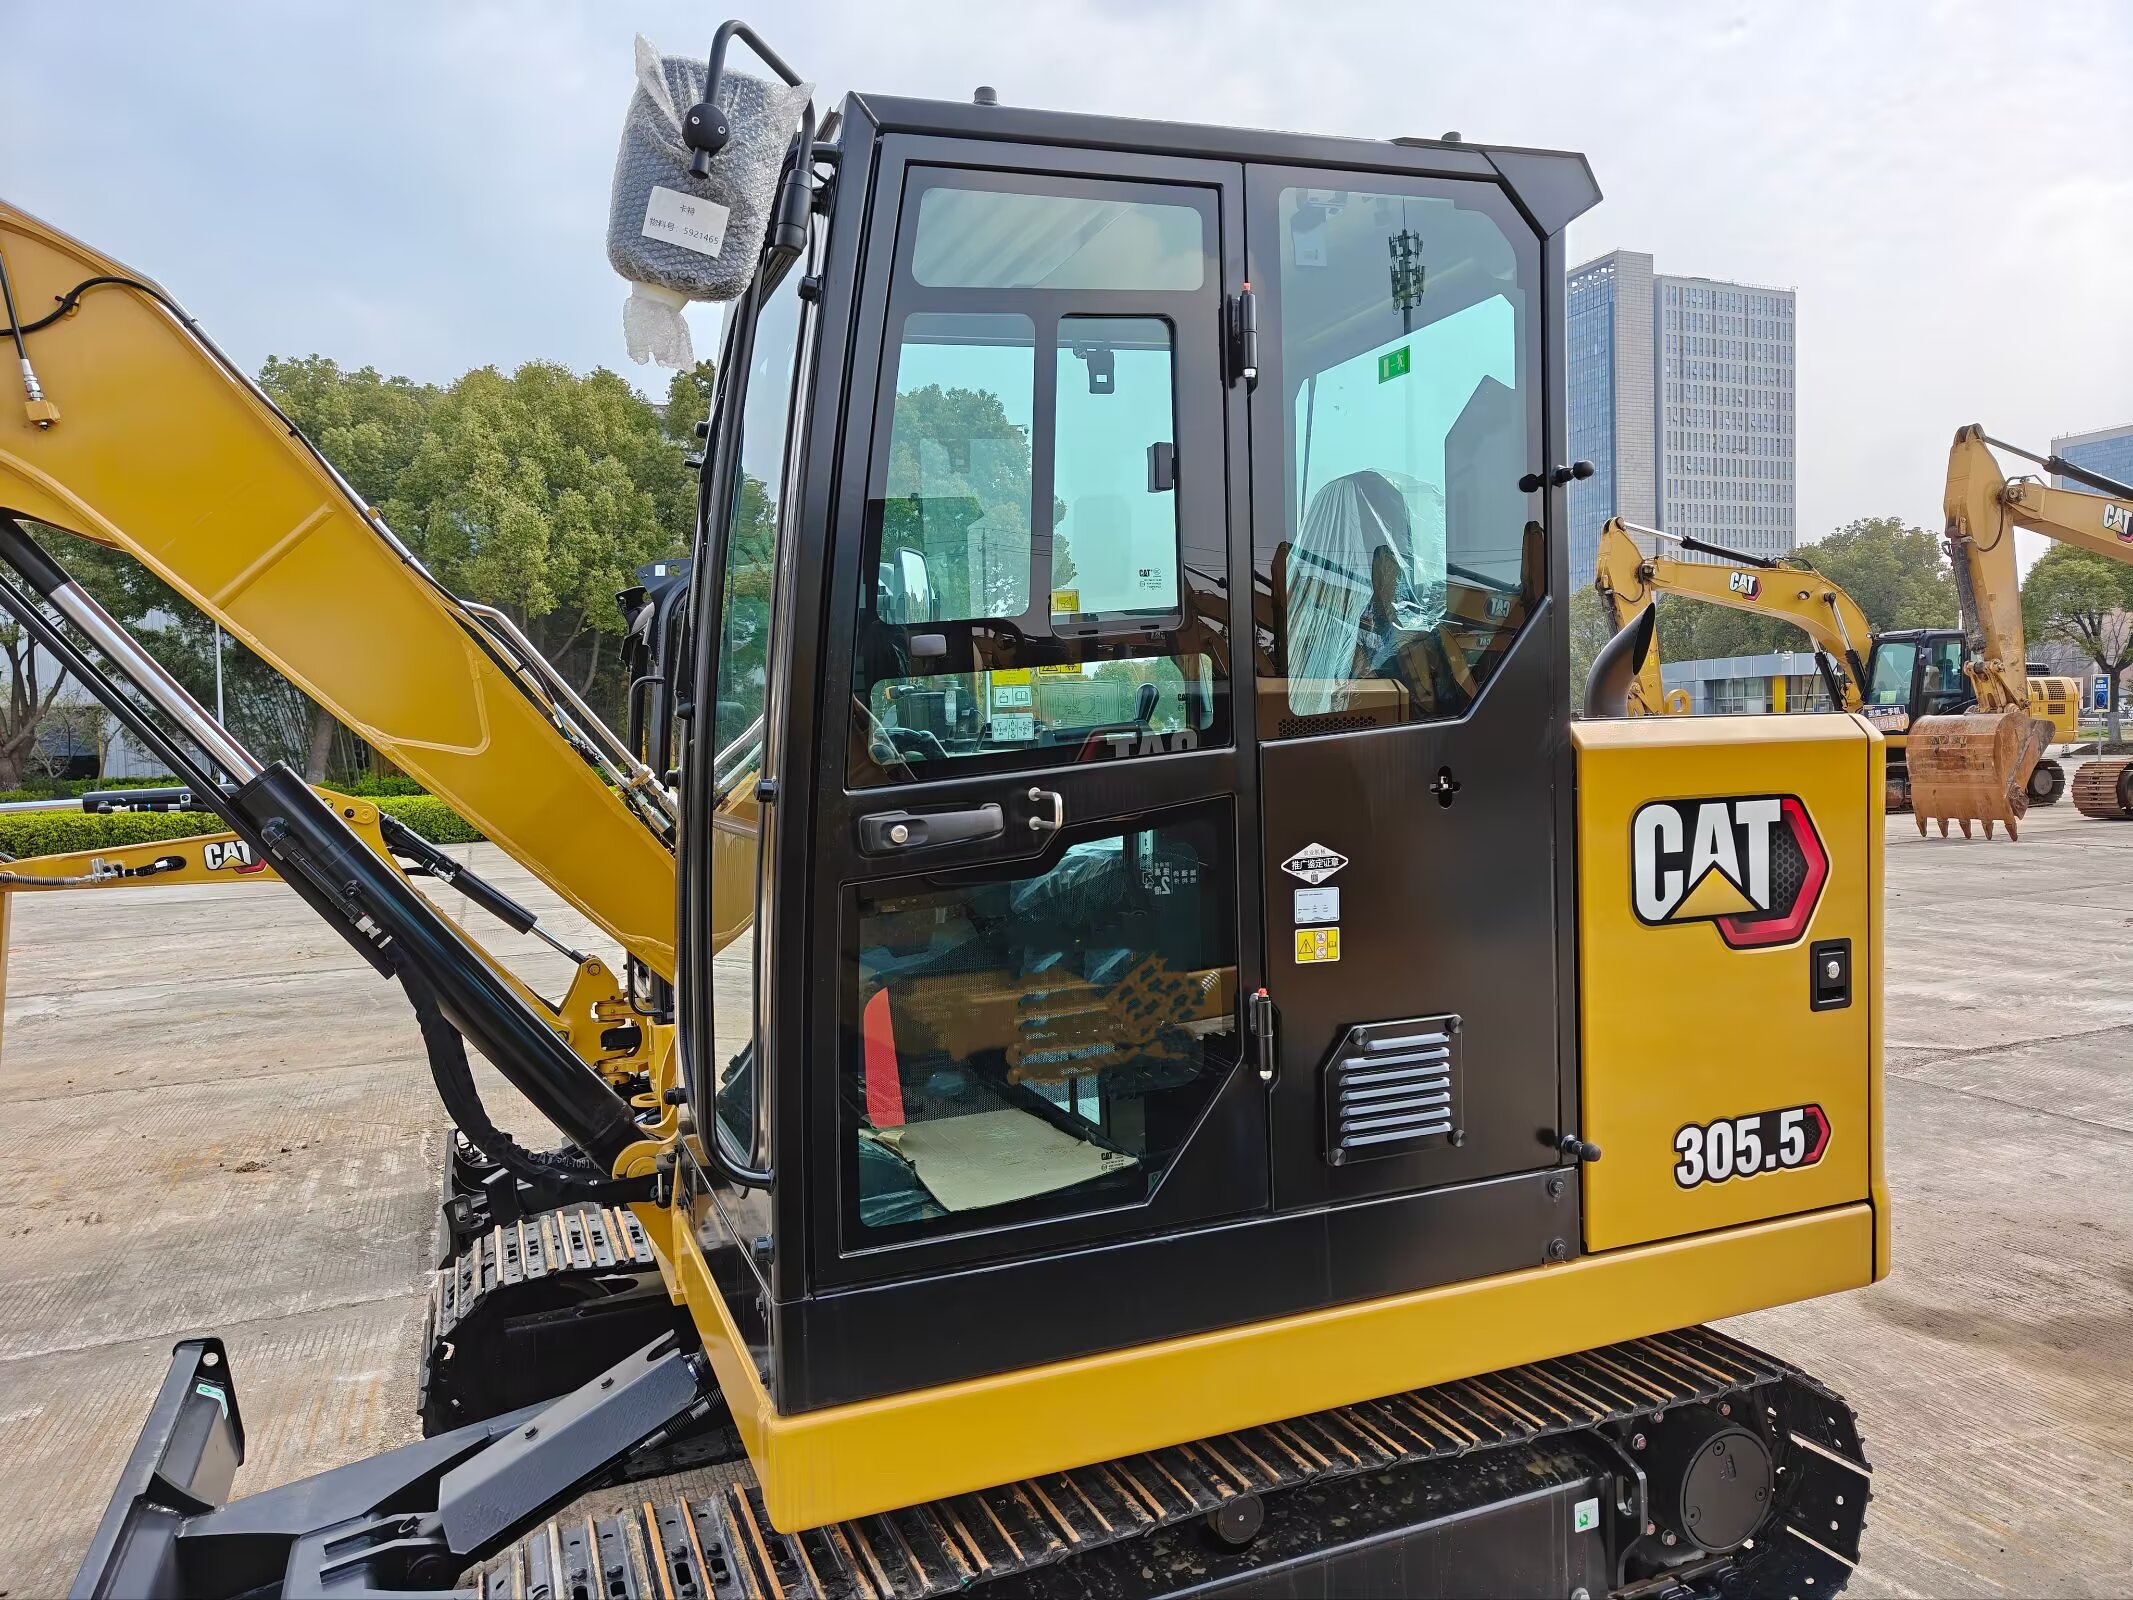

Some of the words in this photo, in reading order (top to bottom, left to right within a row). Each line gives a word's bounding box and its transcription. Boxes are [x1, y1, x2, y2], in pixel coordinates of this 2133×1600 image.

[683, 227, 719, 245] 5921465
[2104, 503, 2133, 534] CAT
[1729, 571, 1756, 595] CAT
[1291, 857, 1339, 870] 推广鉴定证章
[1635, 799, 1781, 921] CAT
[1676, 1109, 1805, 1185] 305.5
